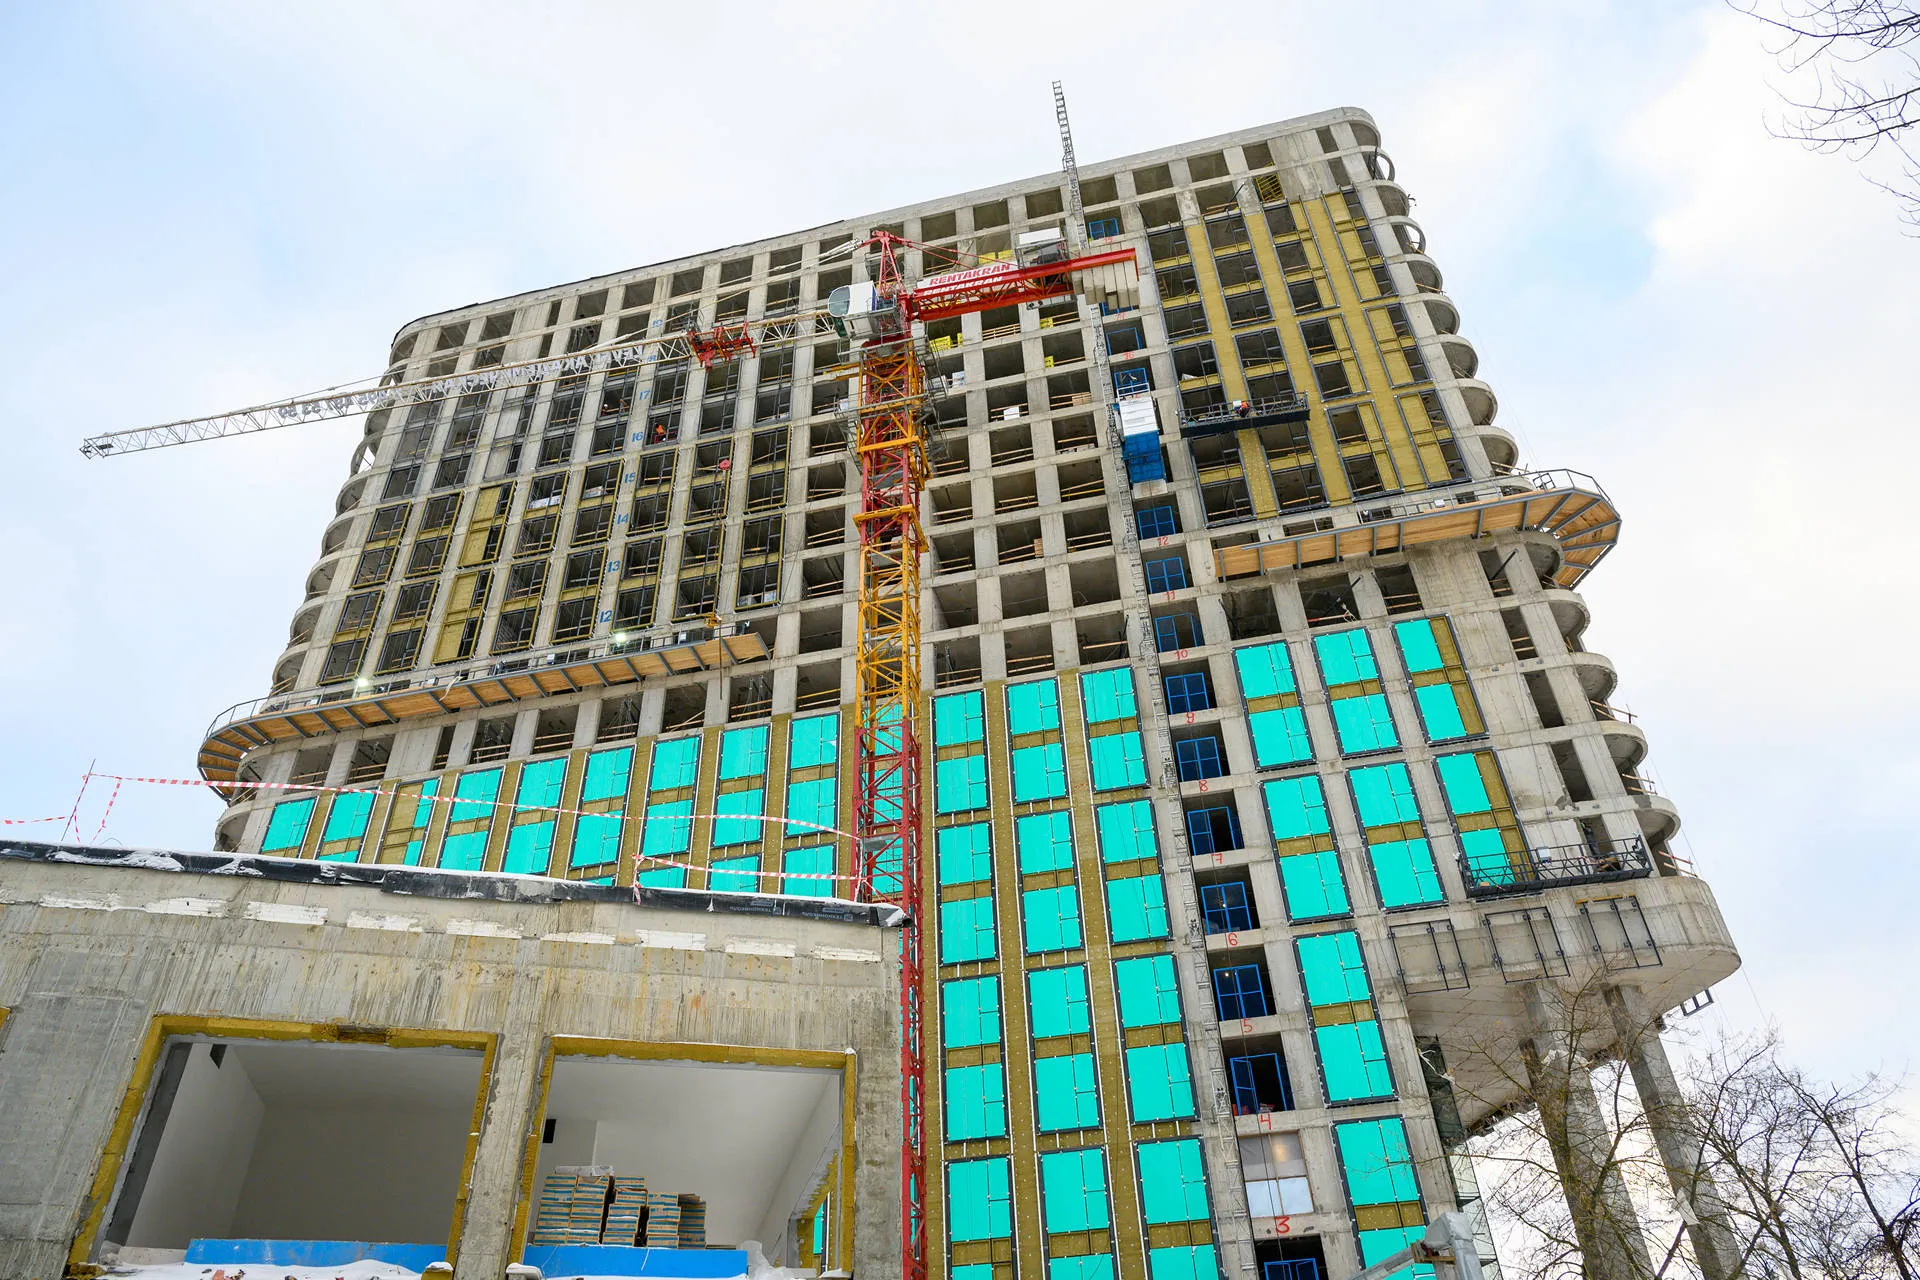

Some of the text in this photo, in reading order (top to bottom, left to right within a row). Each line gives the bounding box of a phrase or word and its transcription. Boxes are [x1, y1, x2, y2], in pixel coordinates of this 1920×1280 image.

[929, 264, 1011, 285] RENTAKRAN
[923, 276, 1003, 296] RENTAKRAN
[640, 389, 651, 400] 17
[632, 431, 645, 442] 16
[624, 471, 636, 483] 15
[616, 513, 629, 525] 14
[1157, 536, 1169, 546] 12
[608, 560, 621, 573] 13
[600, 610, 613, 623] 12
[1174, 649, 1189, 660] 10
[1199, 779, 1208, 792] 8
[1211, 852, 1223, 864] 7
[1228, 932, 1239, 946] 6
[1242, 1018, 1253, 1033] 5
[1260, 1112, 1272, 1130] 4
[1275, 1215, 1290, 1234] 3
